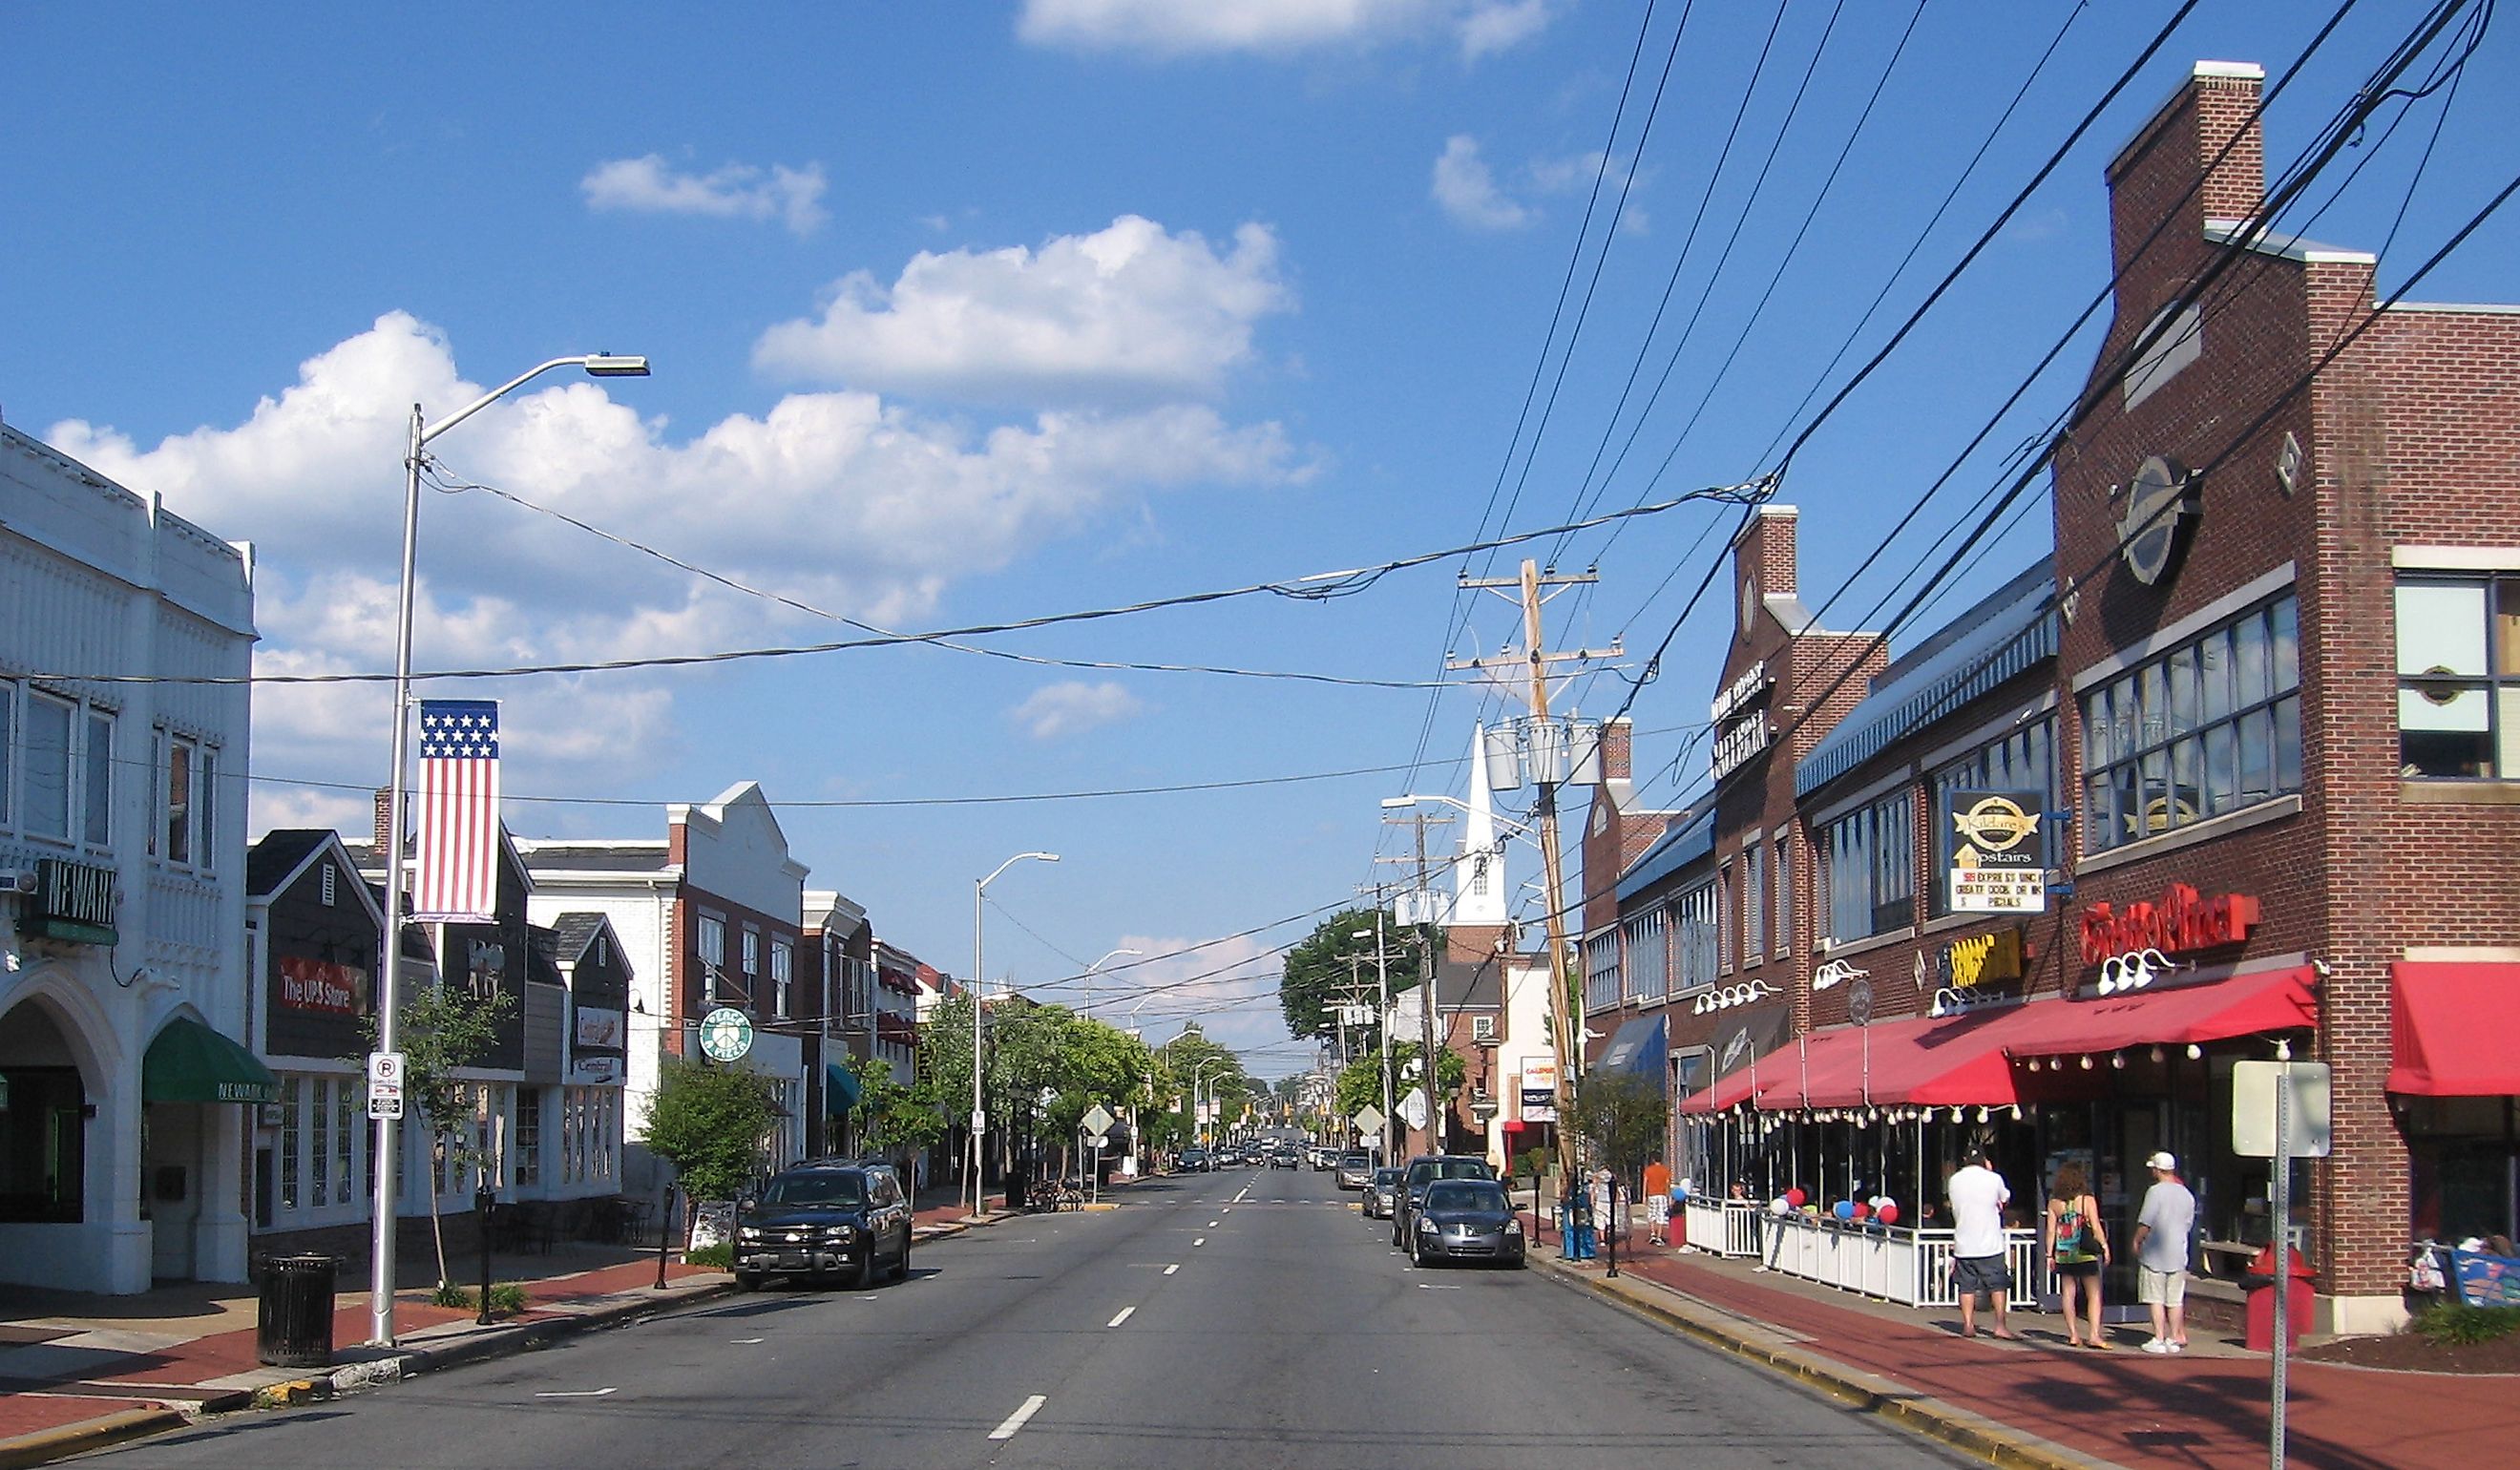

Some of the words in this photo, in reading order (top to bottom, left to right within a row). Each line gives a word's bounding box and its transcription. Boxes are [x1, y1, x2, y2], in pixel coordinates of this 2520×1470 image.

[48, 860, 116, 924] NEWARK
[284, 976, 303, 1001] The
[304, 979, 325, 1004] UPS
[326, 982, 350, 1008] Store
